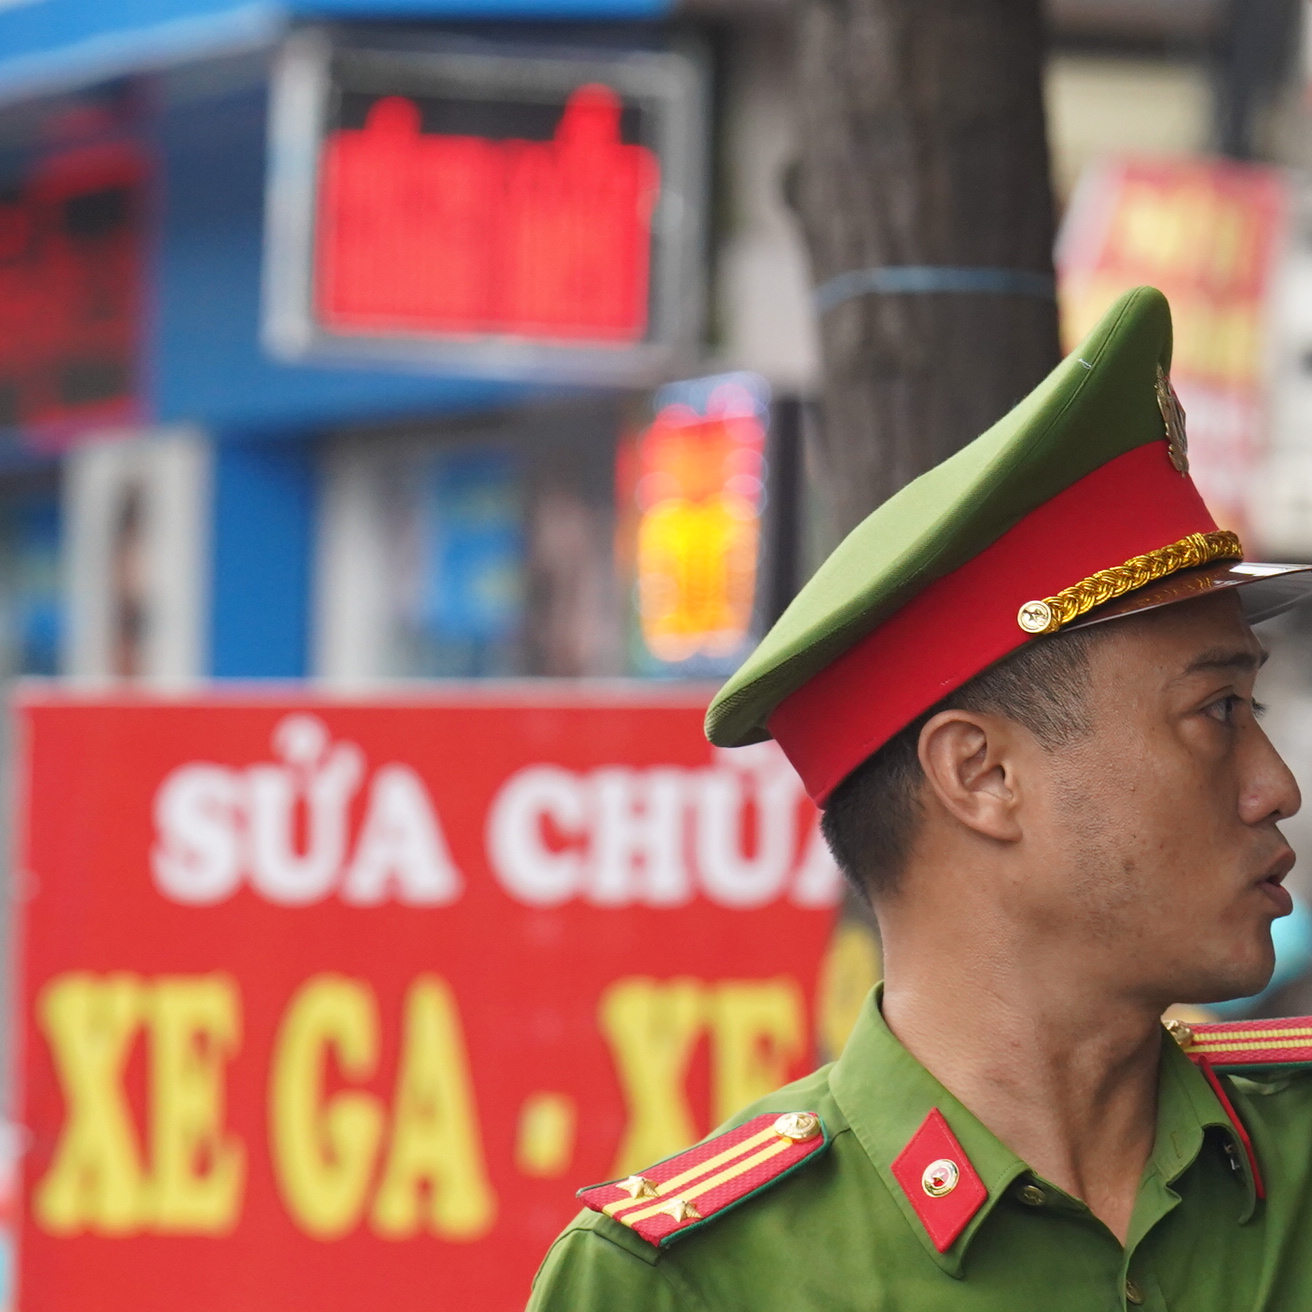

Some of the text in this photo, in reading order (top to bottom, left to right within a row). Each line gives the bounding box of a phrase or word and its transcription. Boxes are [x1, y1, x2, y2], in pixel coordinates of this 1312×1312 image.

[152, 716, 460, 904] SỬA
[42, 974, 244, 1234] XE
[270, 974, 494, 1236] GA
